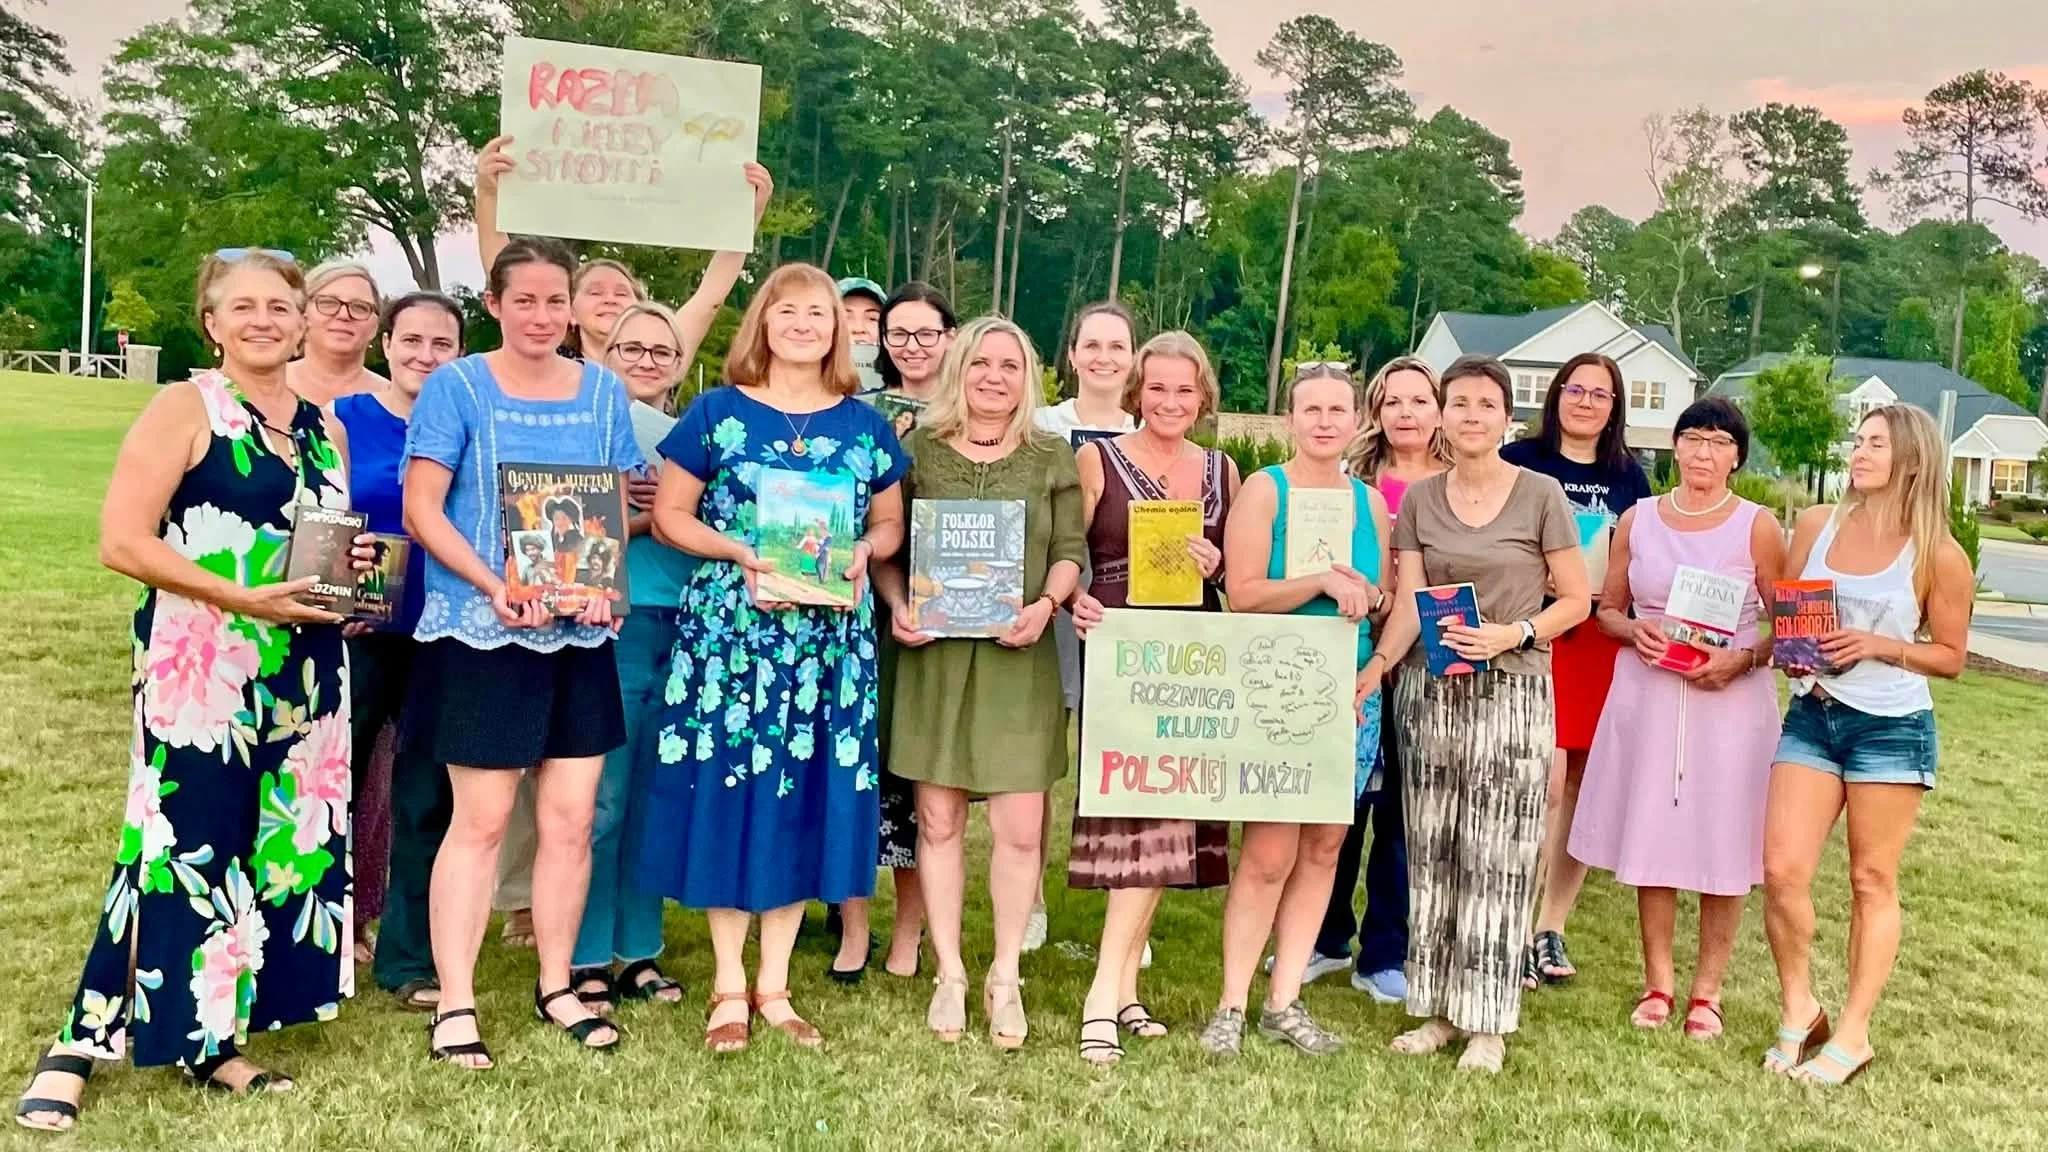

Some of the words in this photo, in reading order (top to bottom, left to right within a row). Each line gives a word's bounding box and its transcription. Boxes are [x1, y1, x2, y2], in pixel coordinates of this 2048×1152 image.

[529, 62, 681, 117] RAZEM
[508, 470, 553, 488] OGNIEM
[565, 472, 614, 490] MIECZEM
[1564, 482, 1609, 495] KRAKÓW
[942, 513, 996, 529] FOLKLOR
[941, 530, 996, 549] POLSKI
[1680, 578, 1736, 605] POLONIA
[1116, 640, 1226, 677] DRUGA
[1130, 681, 1236, 710] ROCZNICA
[1156, 715, 1239, 738] KLUBU
[1100, 750, 1227, 802] POLSKIEJ
